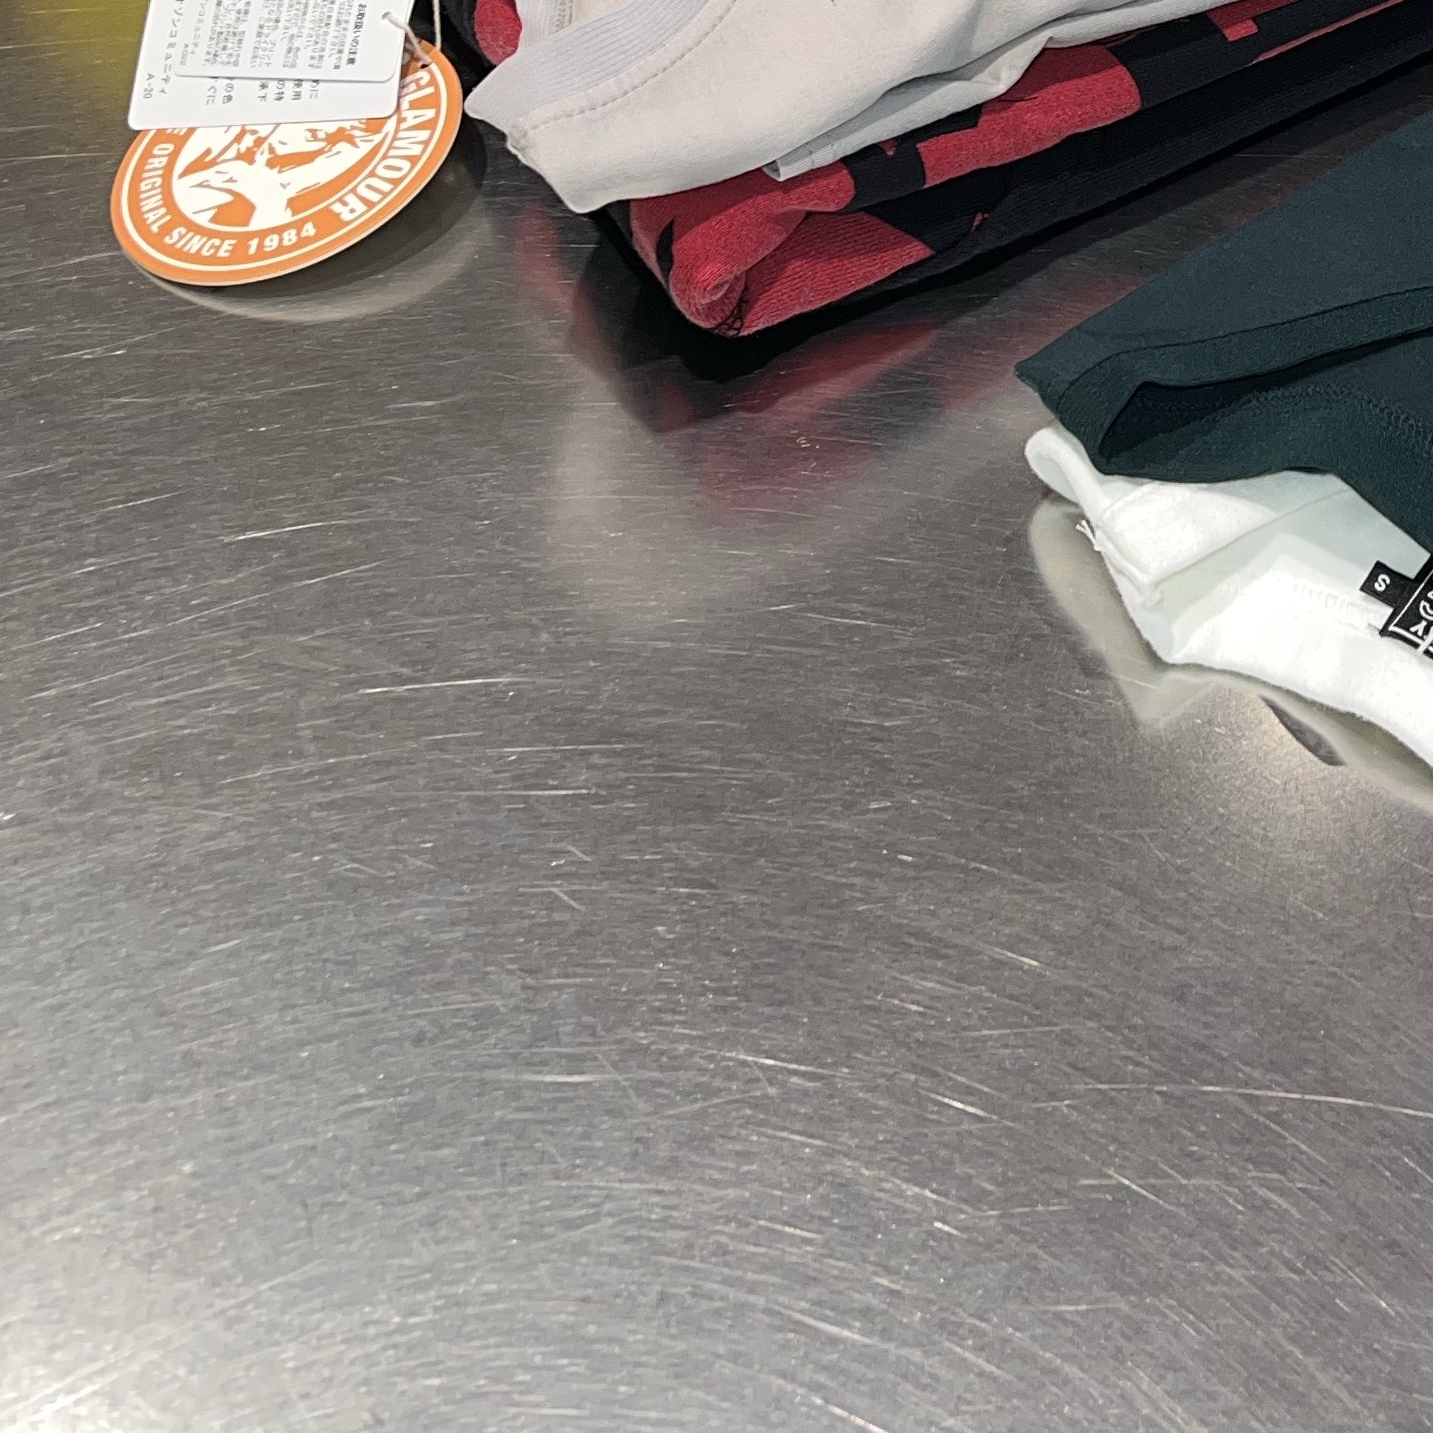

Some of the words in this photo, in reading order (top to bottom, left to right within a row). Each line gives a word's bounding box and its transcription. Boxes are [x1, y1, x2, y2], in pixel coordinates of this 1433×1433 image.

[142, 73, 154, 99] A-20
[329, 66, 438, 224] GLAMOUR
[139, 143, 175, 235] ORIGINAL
[163, 225, 238, 259] SINCE
[246, 221, 317, 256] 1984
[1374, 574, 1391, 592] S
